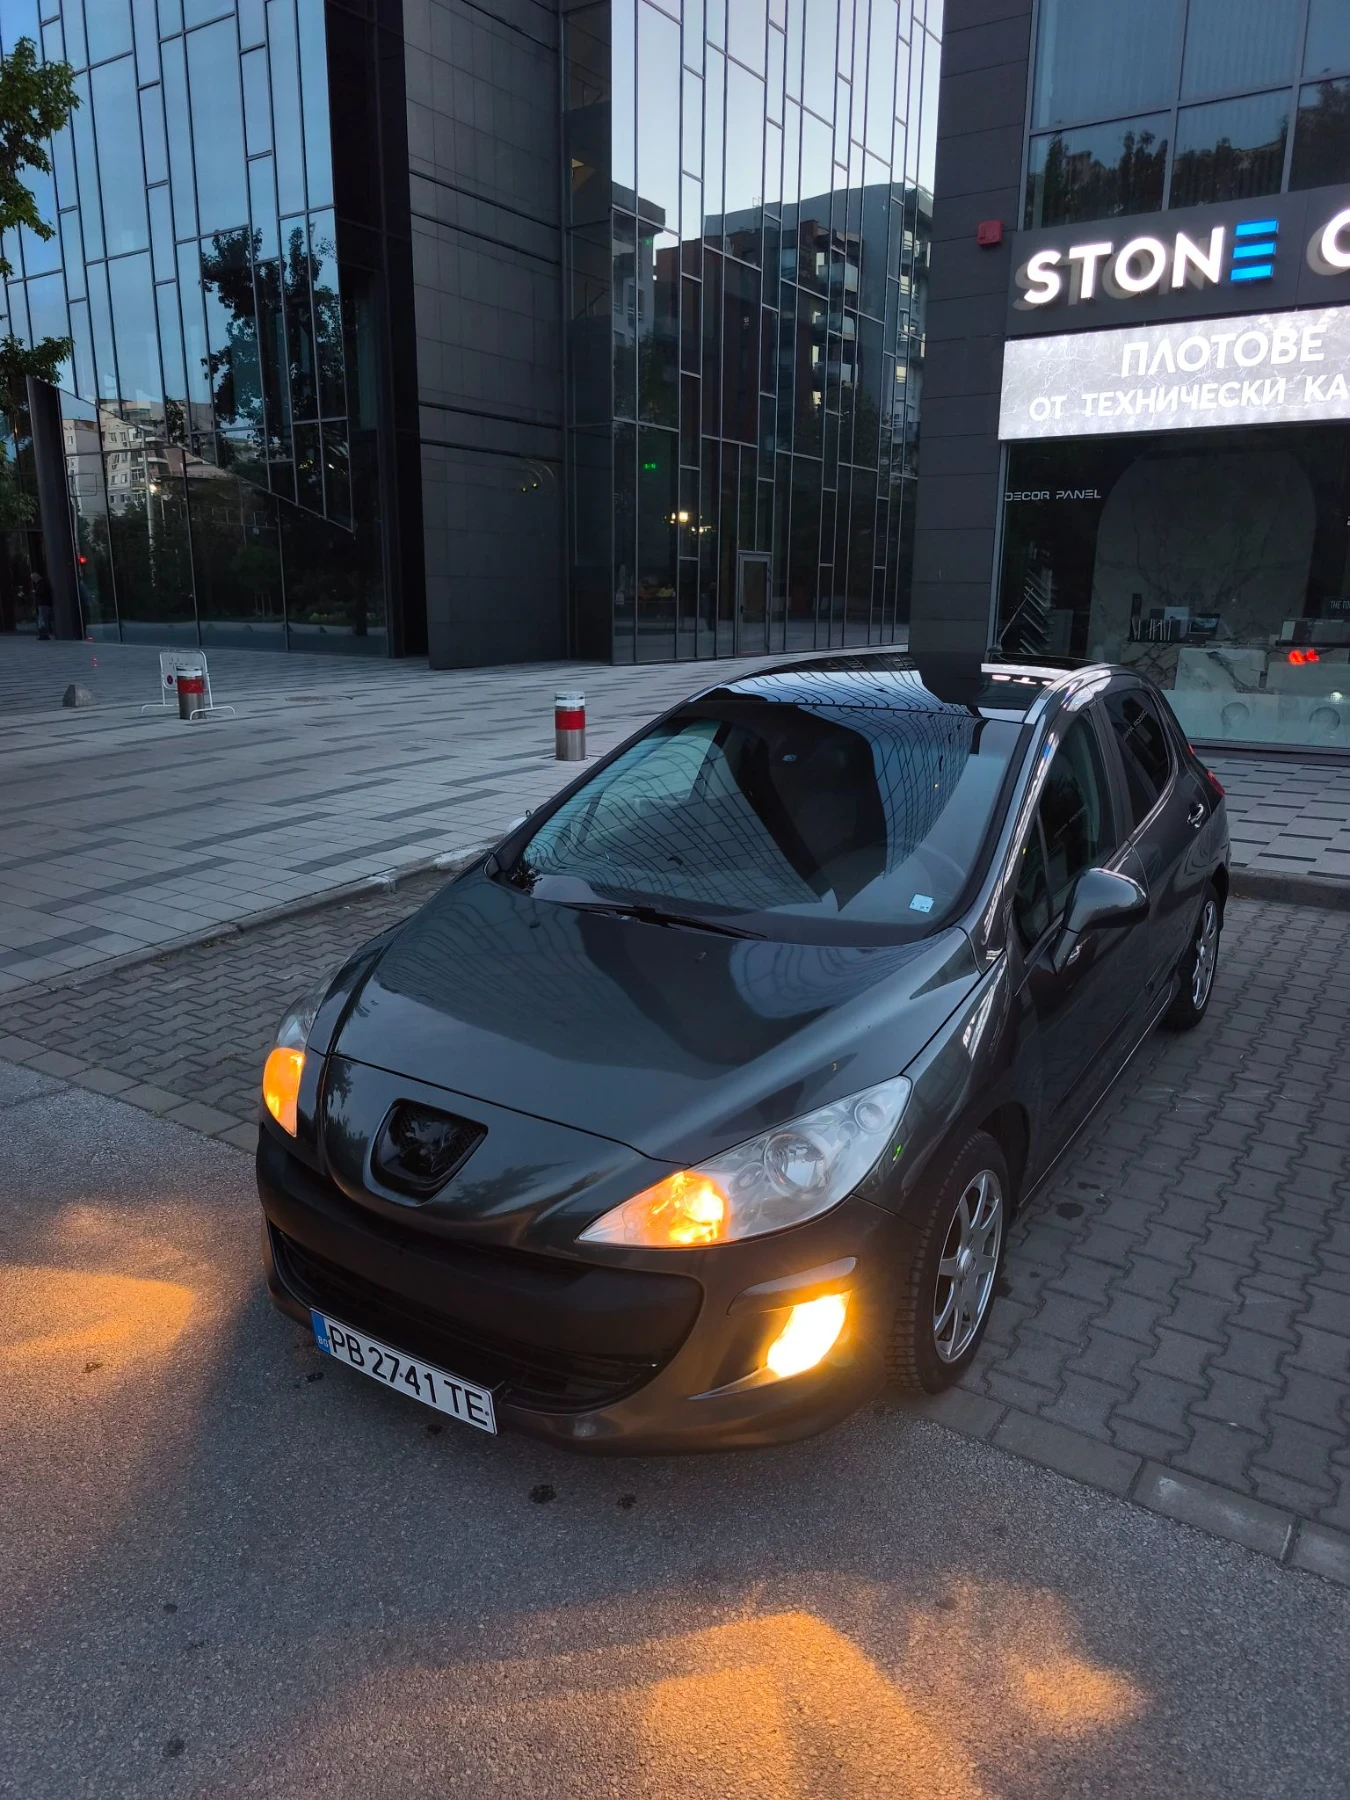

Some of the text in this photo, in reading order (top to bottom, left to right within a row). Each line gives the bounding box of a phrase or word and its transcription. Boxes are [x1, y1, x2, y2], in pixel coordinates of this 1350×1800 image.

[1023, 218, 1278, 304] STONE
[1121, 325, 1327, 378] ПЛОТОВЕ
[1029, 395, 1068, 421] ОТ
[1082, 377, 1286, 417] ТЕХНИЧЕСКИ
[1004, 489, 1102, 501] DECOR PANEL
[328, 1324, 488, 1427] PB 2741 TE
